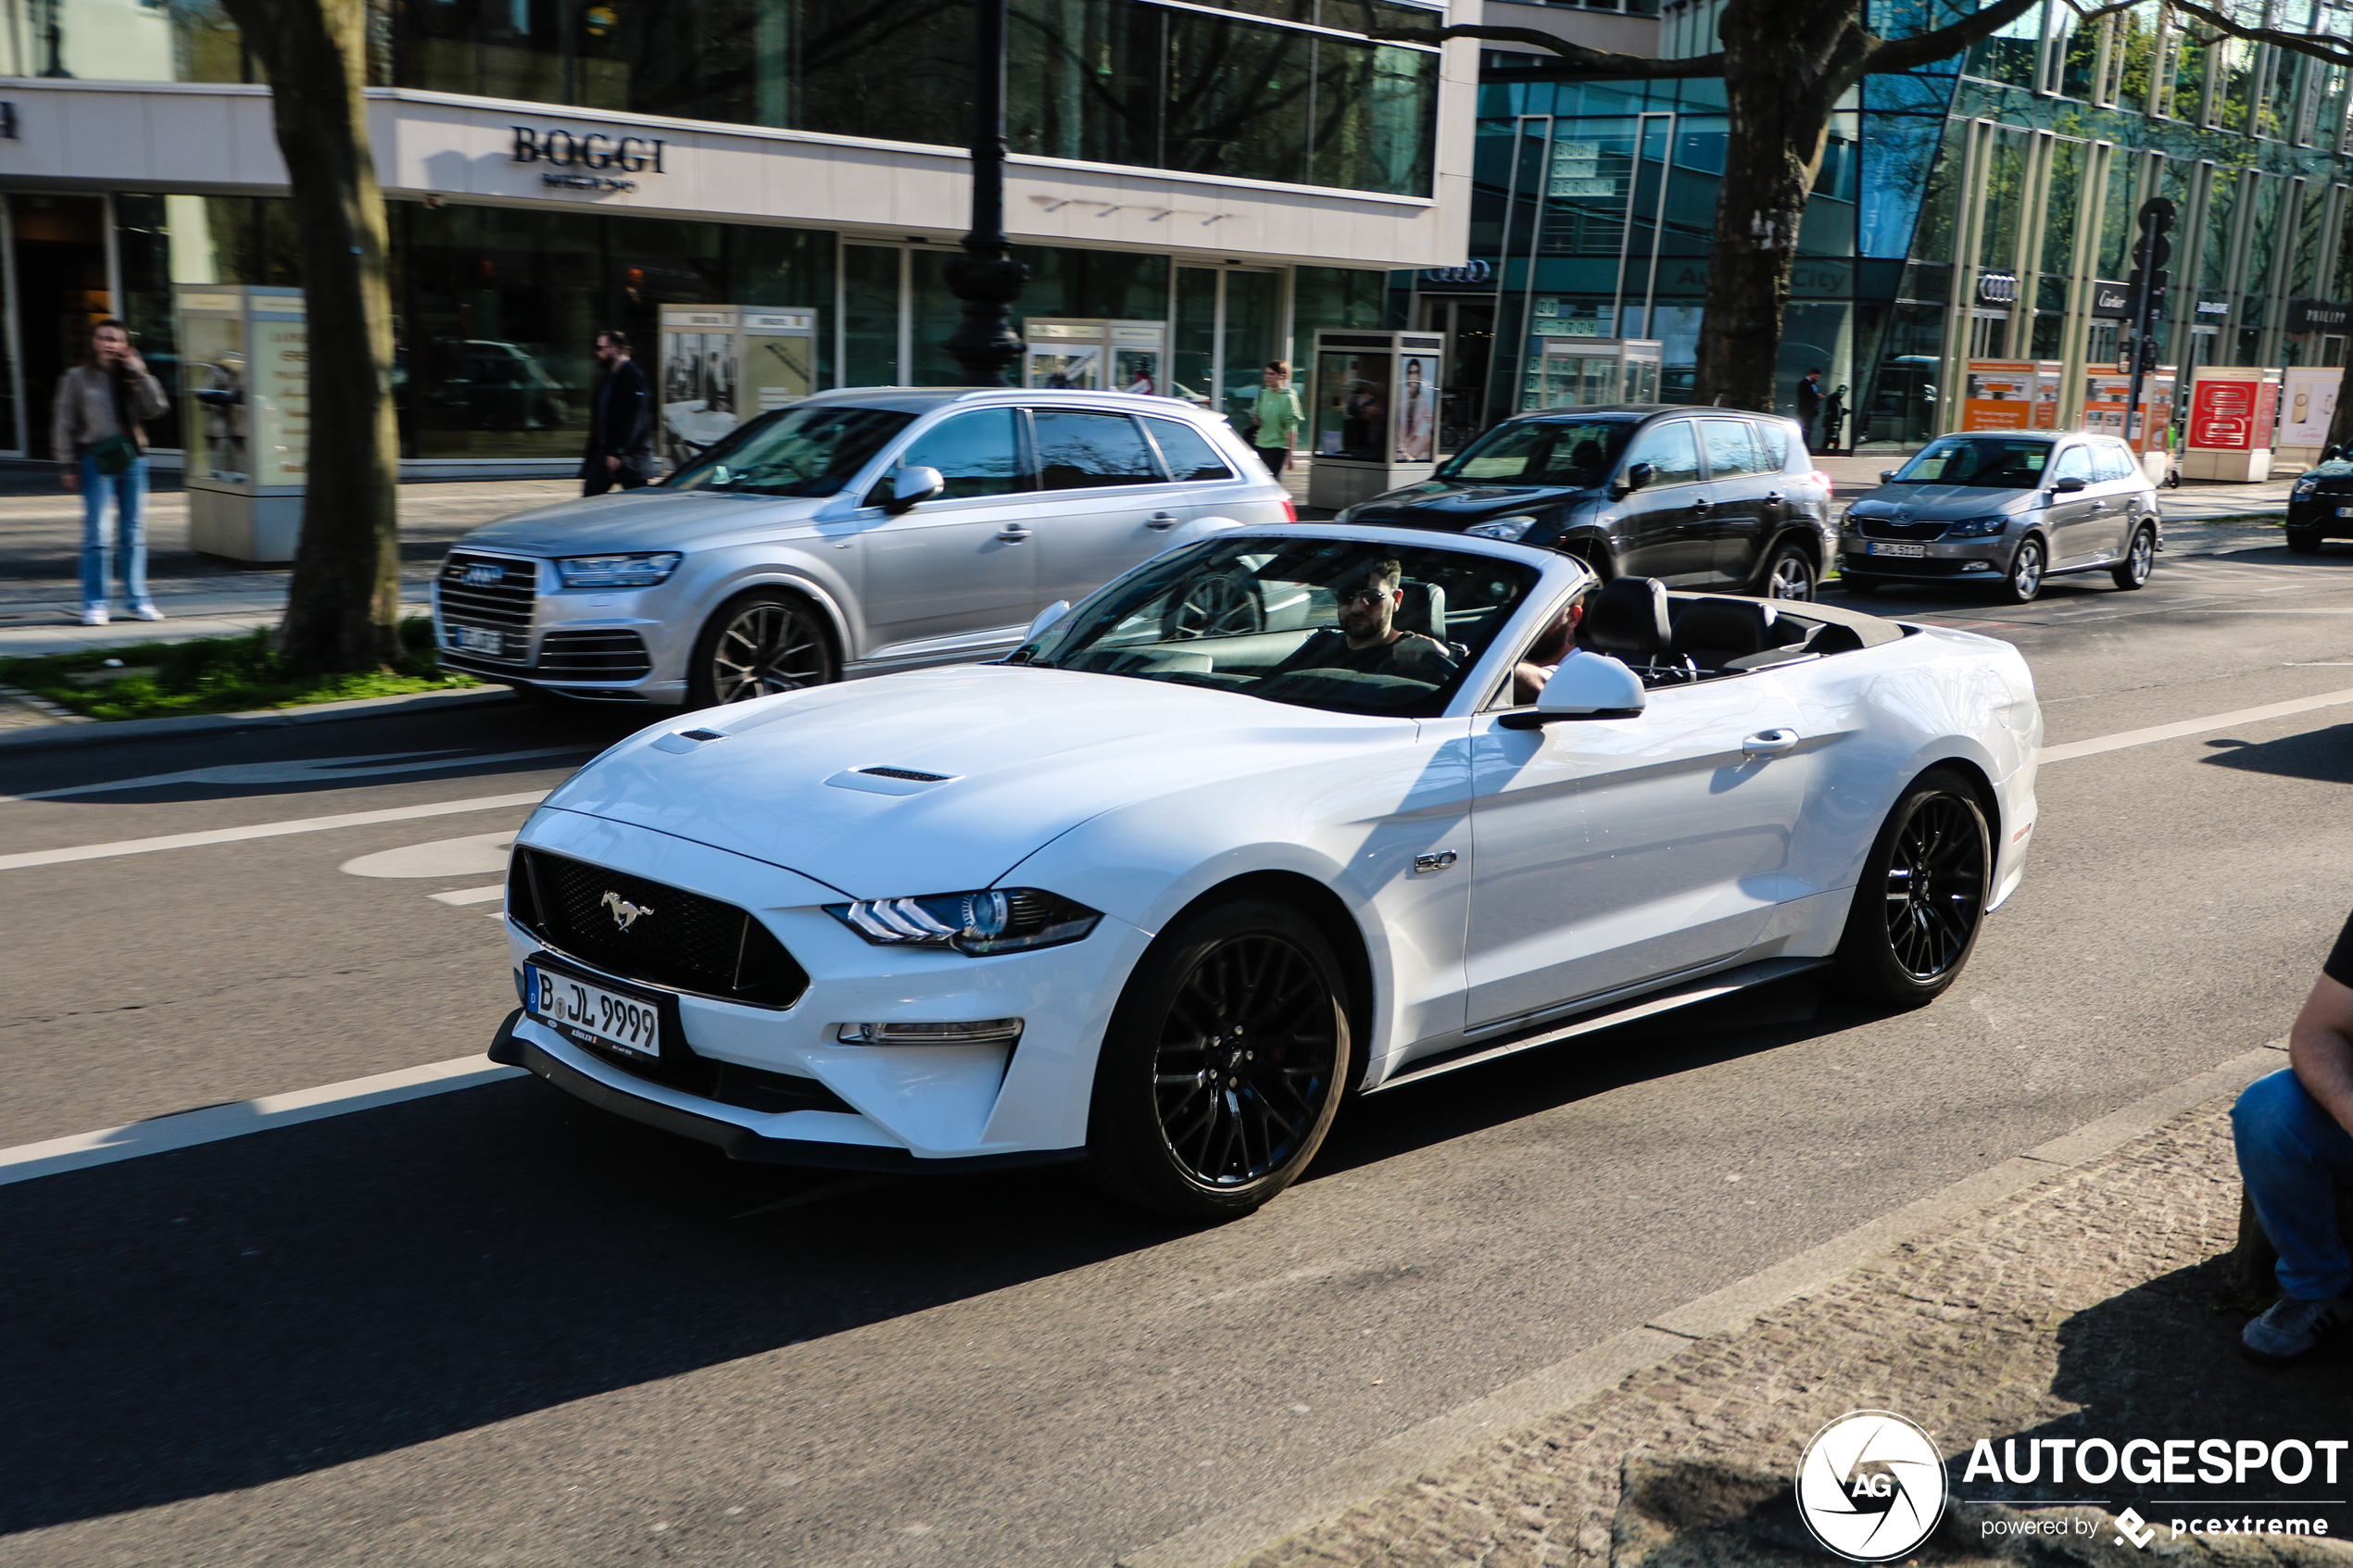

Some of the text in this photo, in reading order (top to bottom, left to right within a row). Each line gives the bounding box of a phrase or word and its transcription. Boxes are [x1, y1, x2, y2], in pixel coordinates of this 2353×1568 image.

[509, 125, 667, 174] BOGGI
[1793, 268, 1847, 293] City
[2098, 290, 2126, 308] Cartier
[2306, 309, 2347, 323] PHILIPP
[531, 992, 536, 1004] D
[539, 972, 656, 1048] B JL 9999
